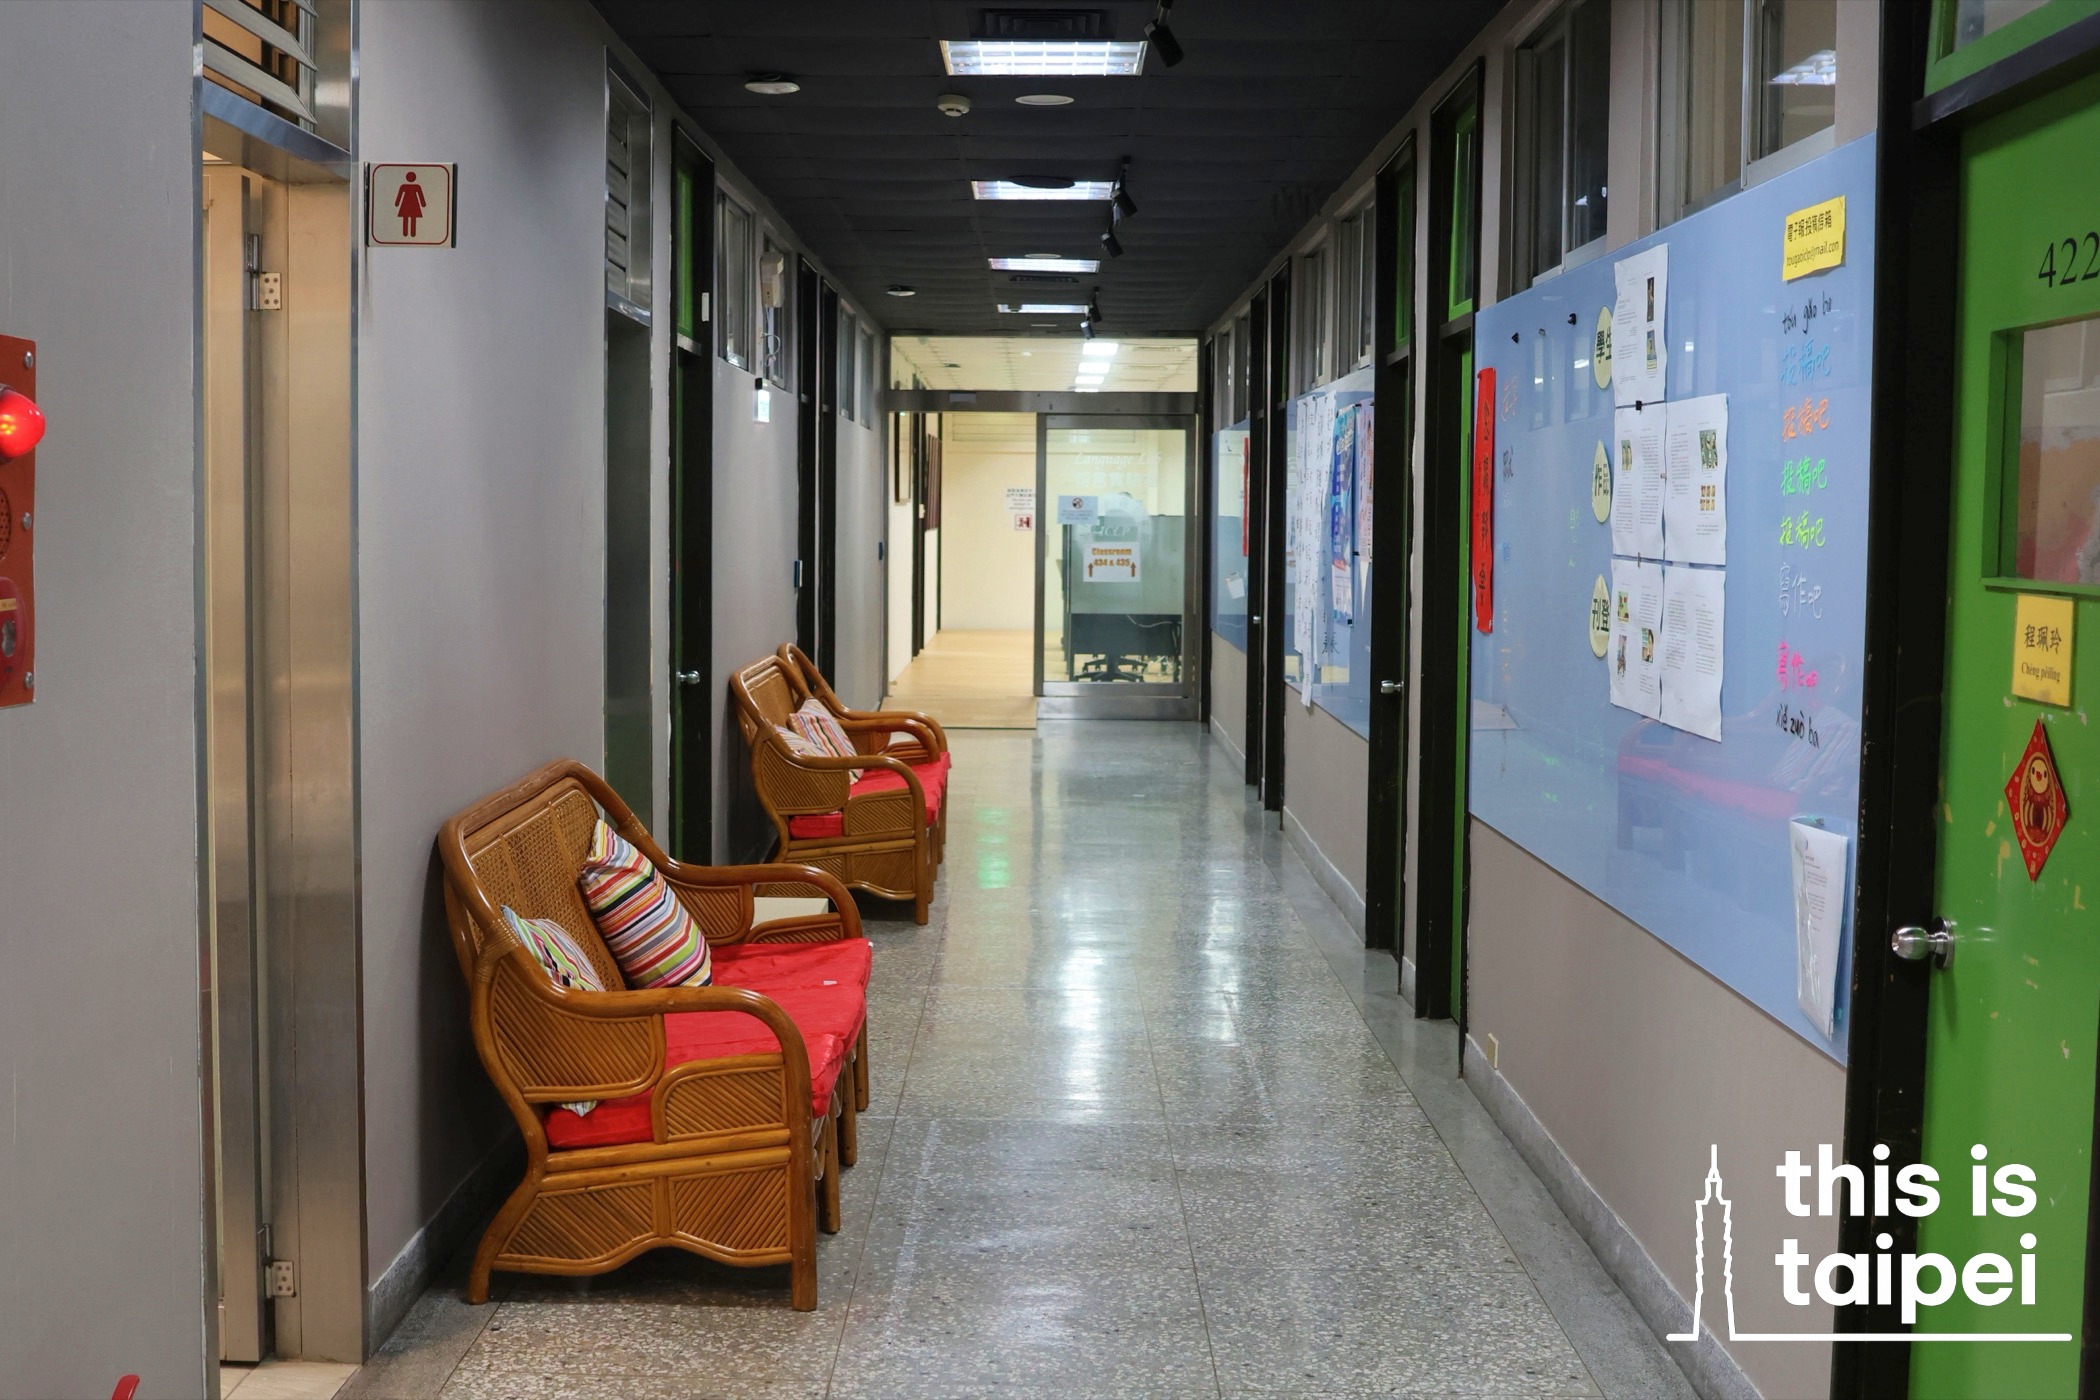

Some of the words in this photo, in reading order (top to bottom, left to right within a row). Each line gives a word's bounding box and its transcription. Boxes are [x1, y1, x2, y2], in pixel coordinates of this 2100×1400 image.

[1787, 210, 1832, 242] 電子報投稿信箱
[2038, 231, 2100, 288] 422
[1075, 453, 1133, 470] Language
[1781, 456, 1828, 497] 投稿吧
[1594, 463, 1609, 497] 作品
[1780, 510, 1826, 550] 投稿吧
[1091, 547, 1133, 556] Classroom
[1093, 558, 1108, 567] 434
[1116, 558, 1131, 567] 435
[1592, 598, 1610, 632] 刊登
[2024, 624, 2062, 655] 程珮玲
